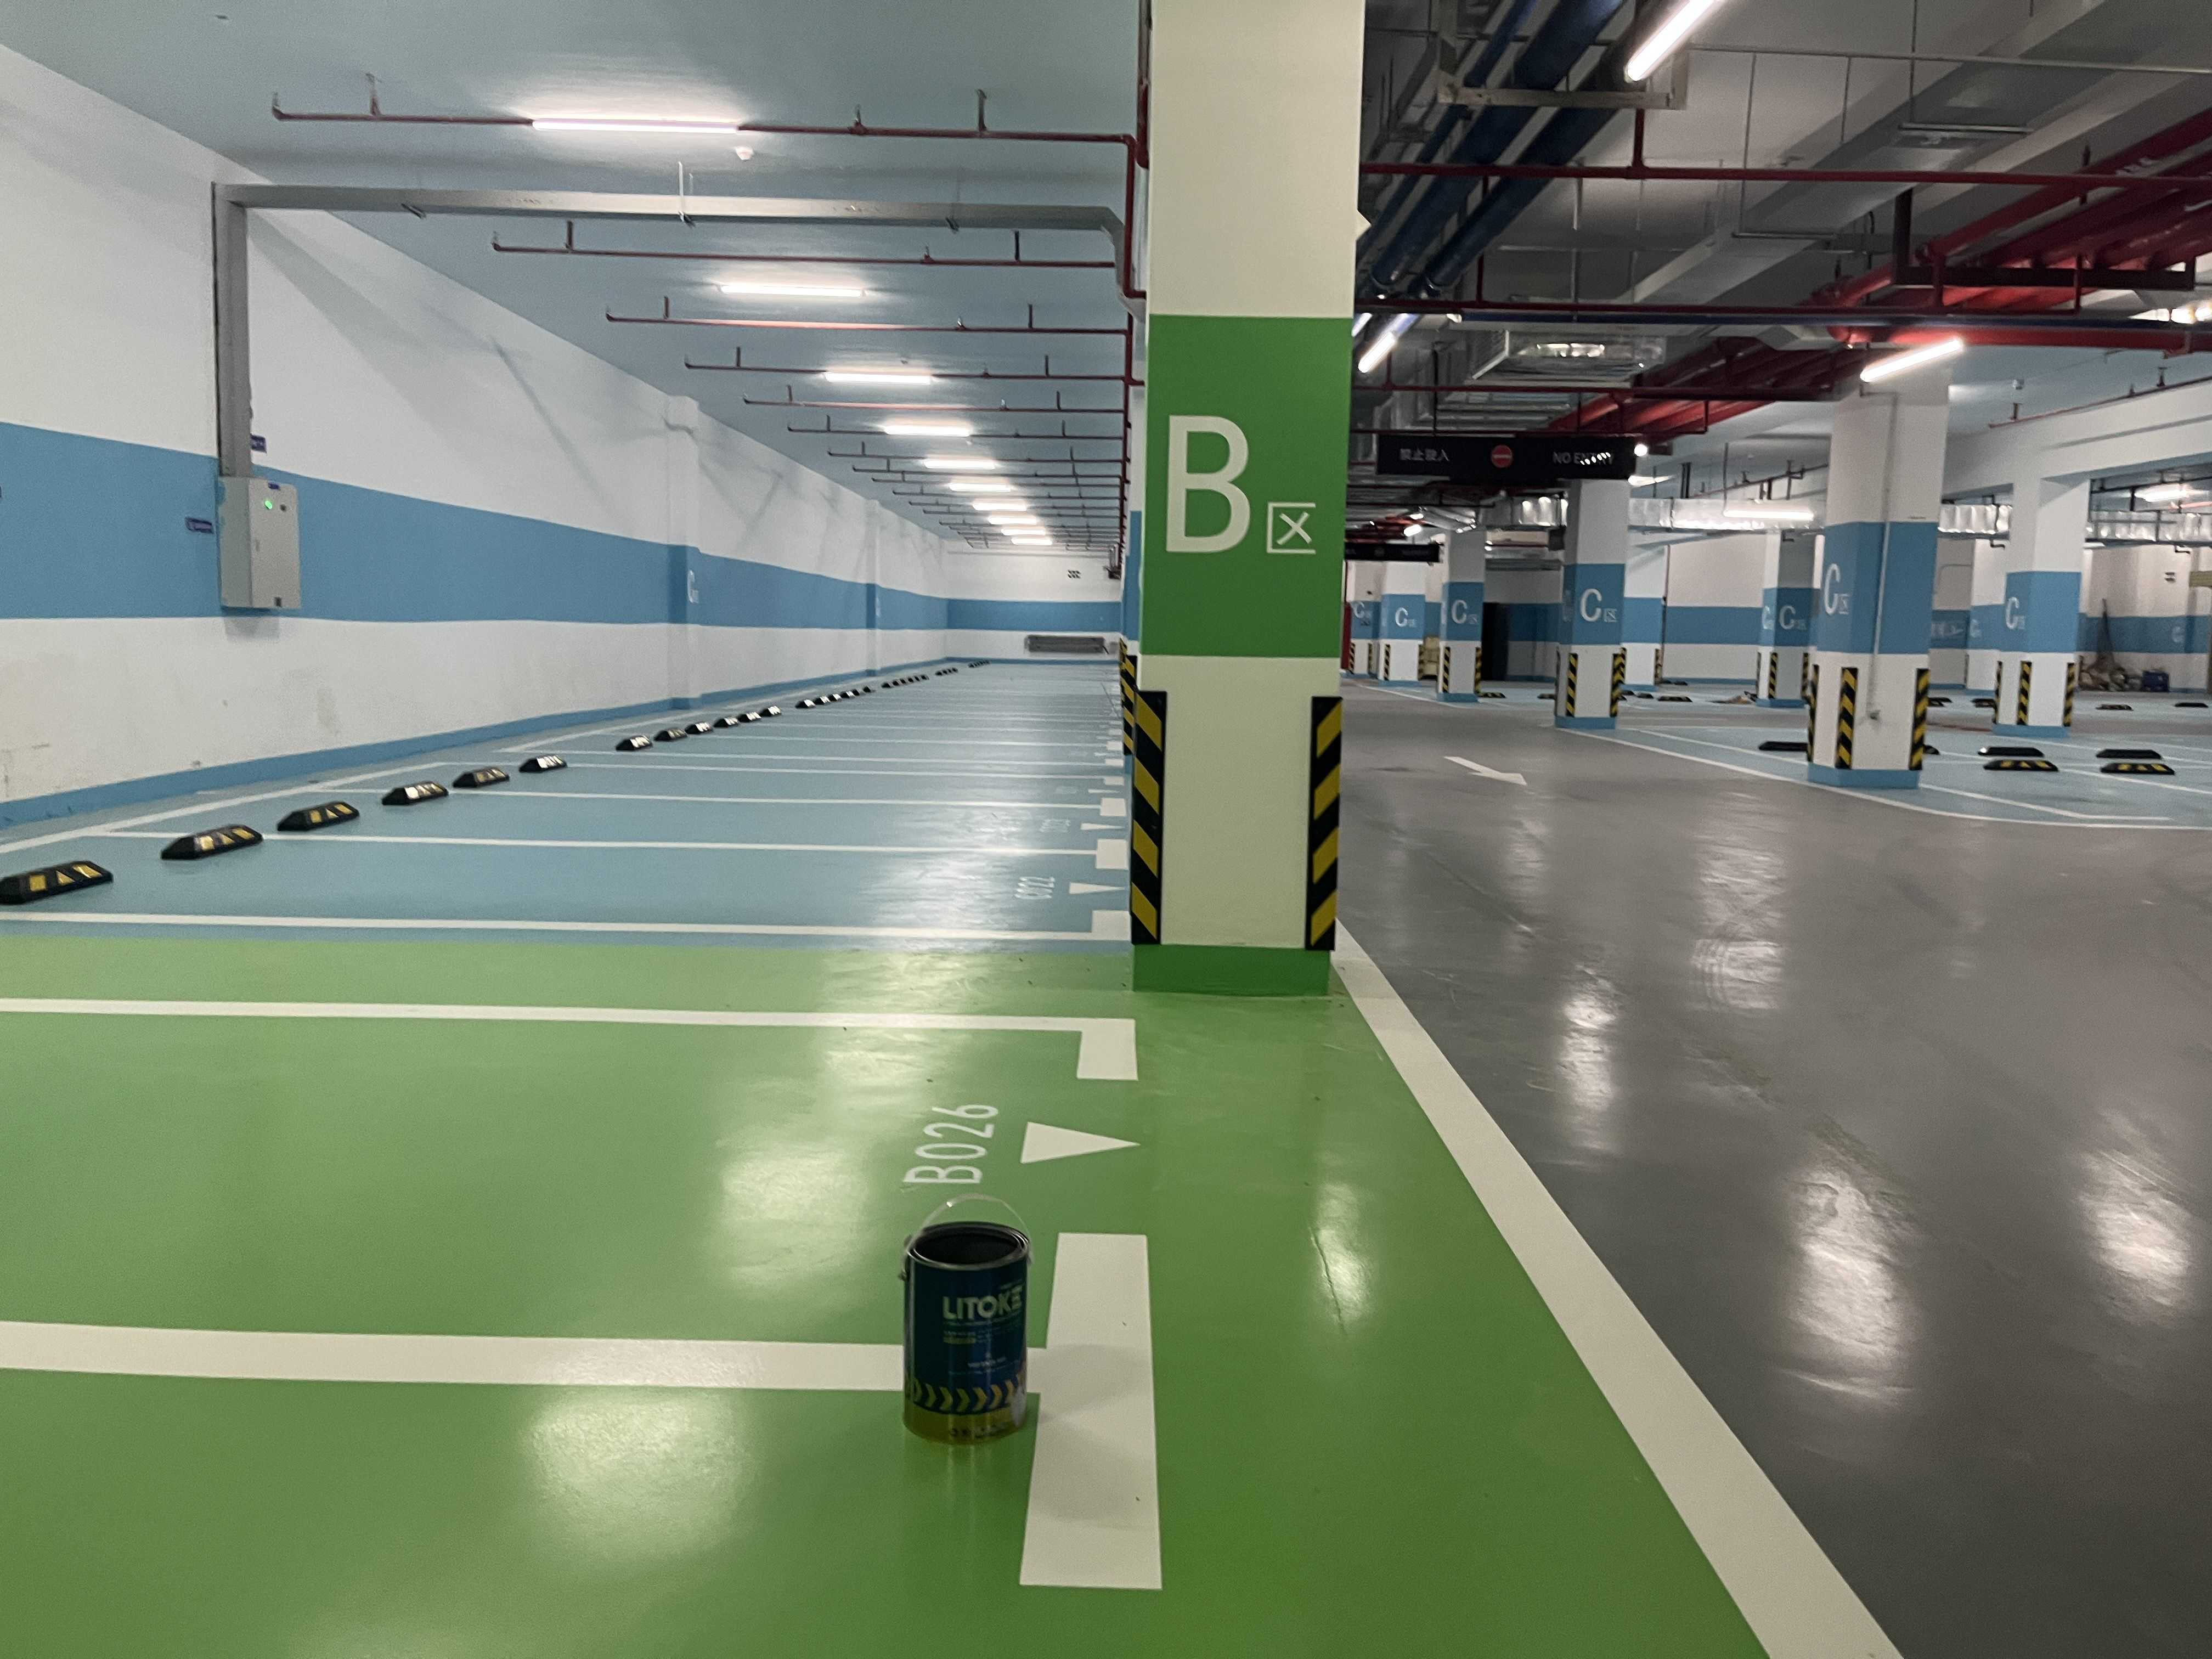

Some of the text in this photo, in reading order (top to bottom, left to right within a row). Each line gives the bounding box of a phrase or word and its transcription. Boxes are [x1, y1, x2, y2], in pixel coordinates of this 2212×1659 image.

[1166, 415, 1316, 554] B区
[1553, 452, 1572, 465] NO
[902, 1104, 999, 1184] B026
